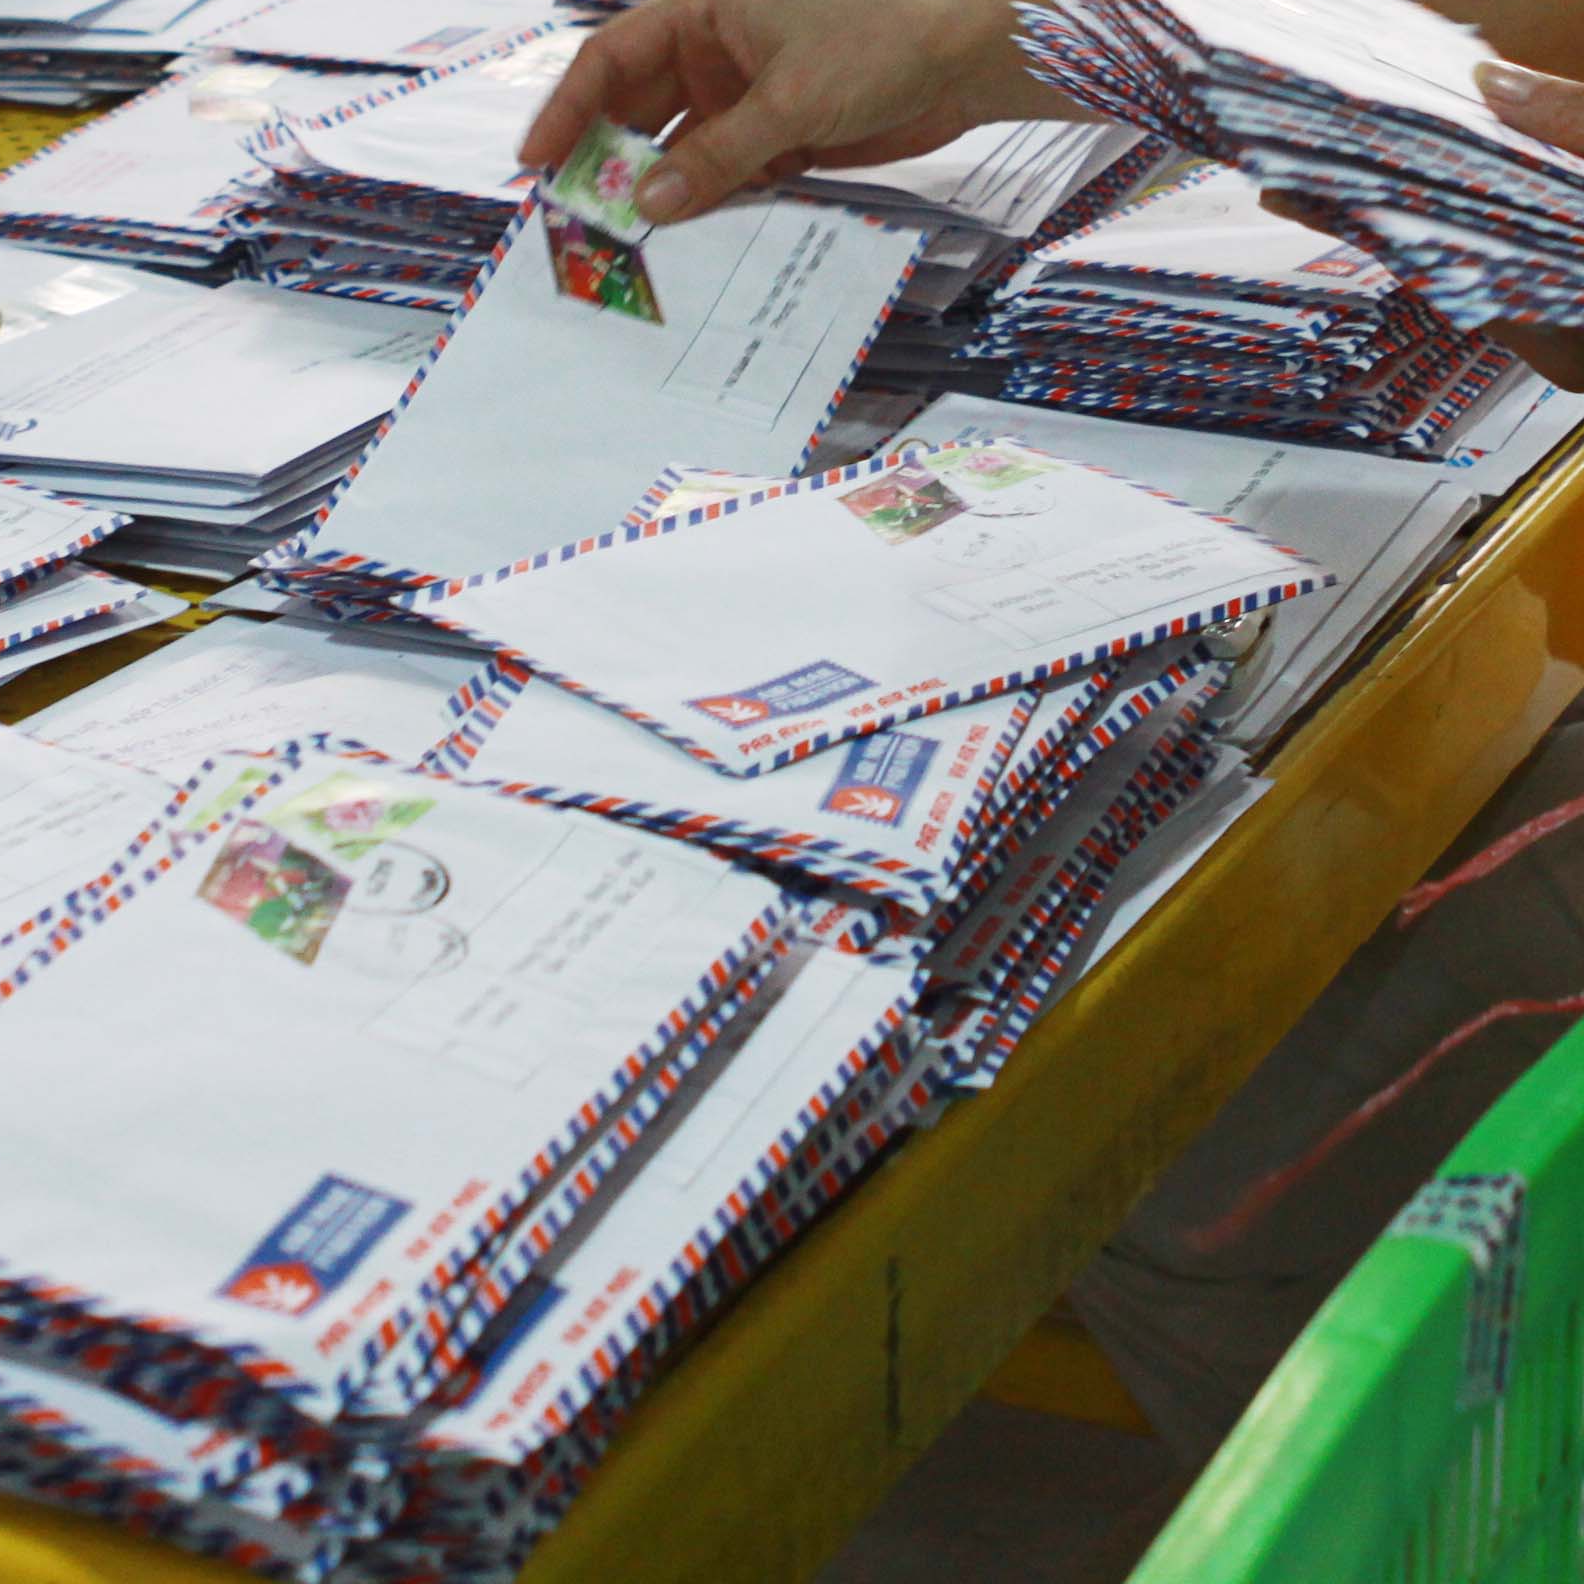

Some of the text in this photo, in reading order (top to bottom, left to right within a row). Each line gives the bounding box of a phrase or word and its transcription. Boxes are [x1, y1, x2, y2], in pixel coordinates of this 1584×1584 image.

[738, 733, 777, 756] PAR
[877, 690, 908, 709] AIR
[906, 676, 948, 695] MAIL
[915, 822, 942, 853] PAR
